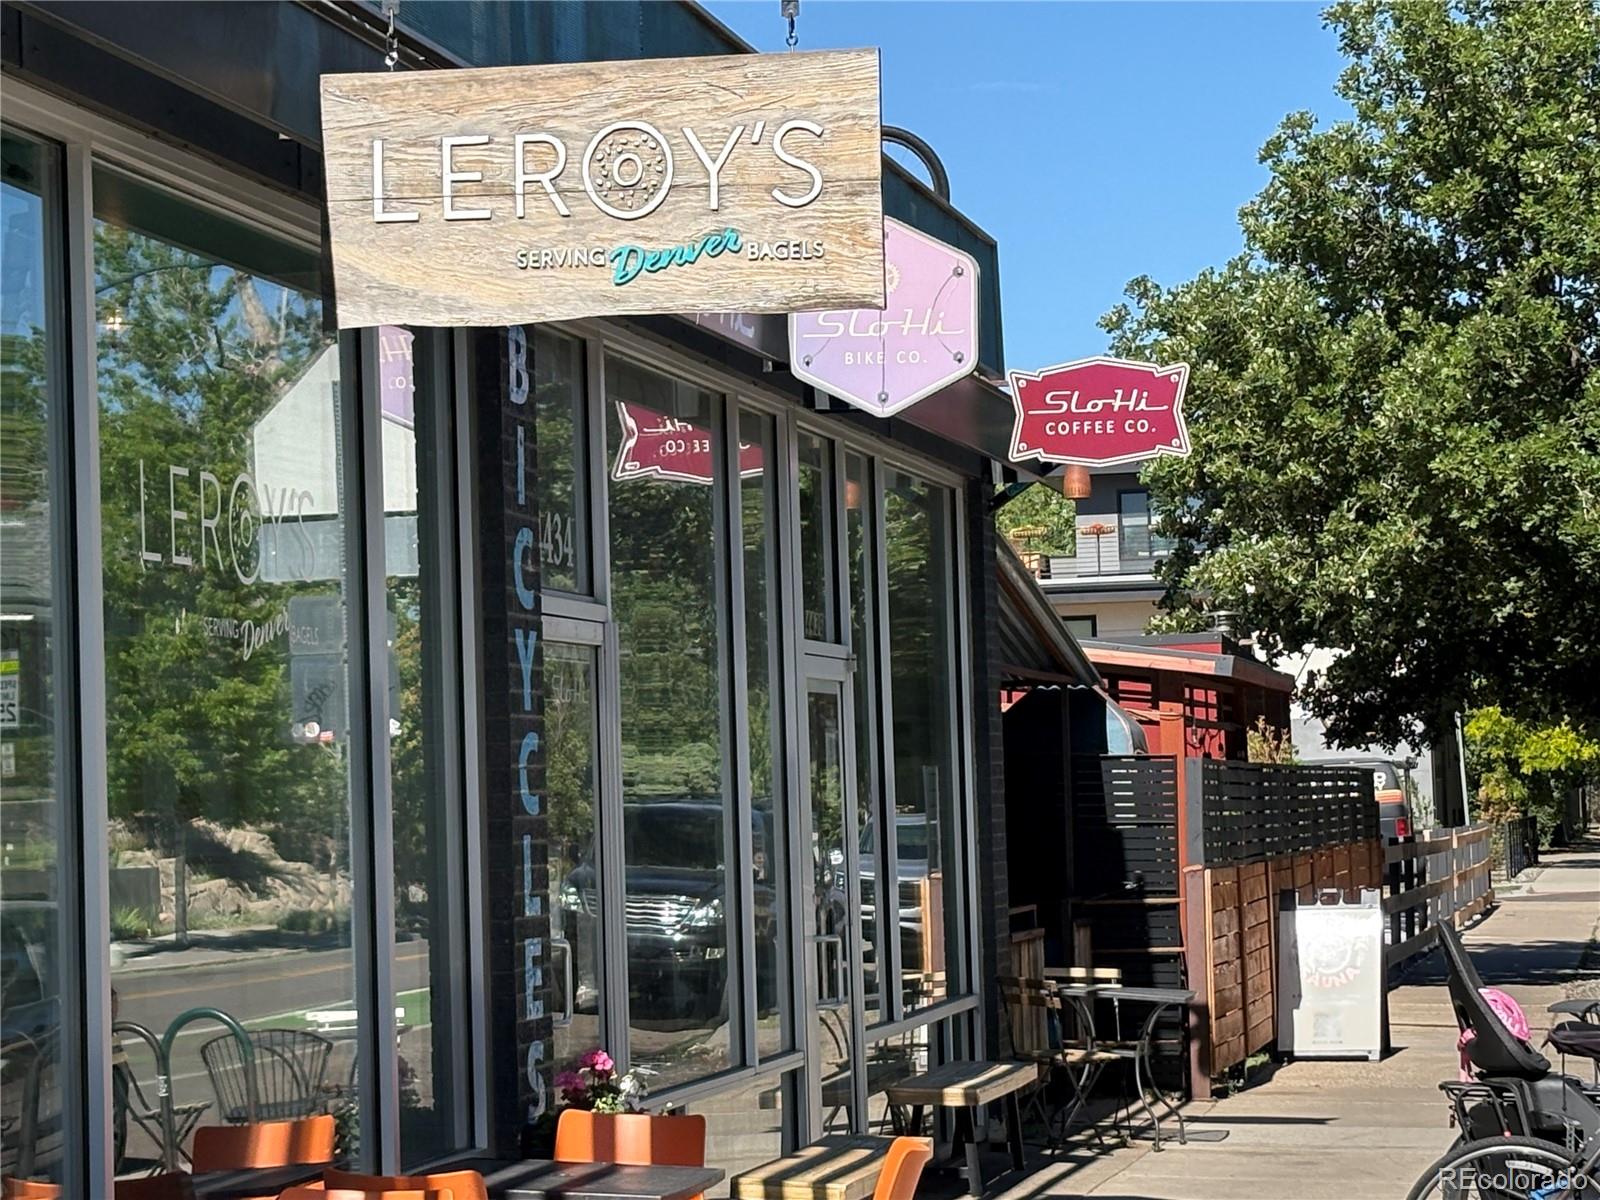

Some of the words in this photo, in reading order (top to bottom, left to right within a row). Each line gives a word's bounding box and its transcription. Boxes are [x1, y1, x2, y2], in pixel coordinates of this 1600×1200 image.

[372, 119, 825, 223] LEROY'S
[516, 249, 607, 269] SERVING
[609, 227, 744, 287] Denver
[746, 239, 824, 260] BAGELS
[844, 350, 884, 366] BIKE
[896, 350, 929, 365] CO.
[1045, 420, 1115, 436] COFFEE
[1124, 419, 1157, 434] CO.
[240, 606, 289, 661] Denver
[508, 325, 546, 1124] BICYCLES
